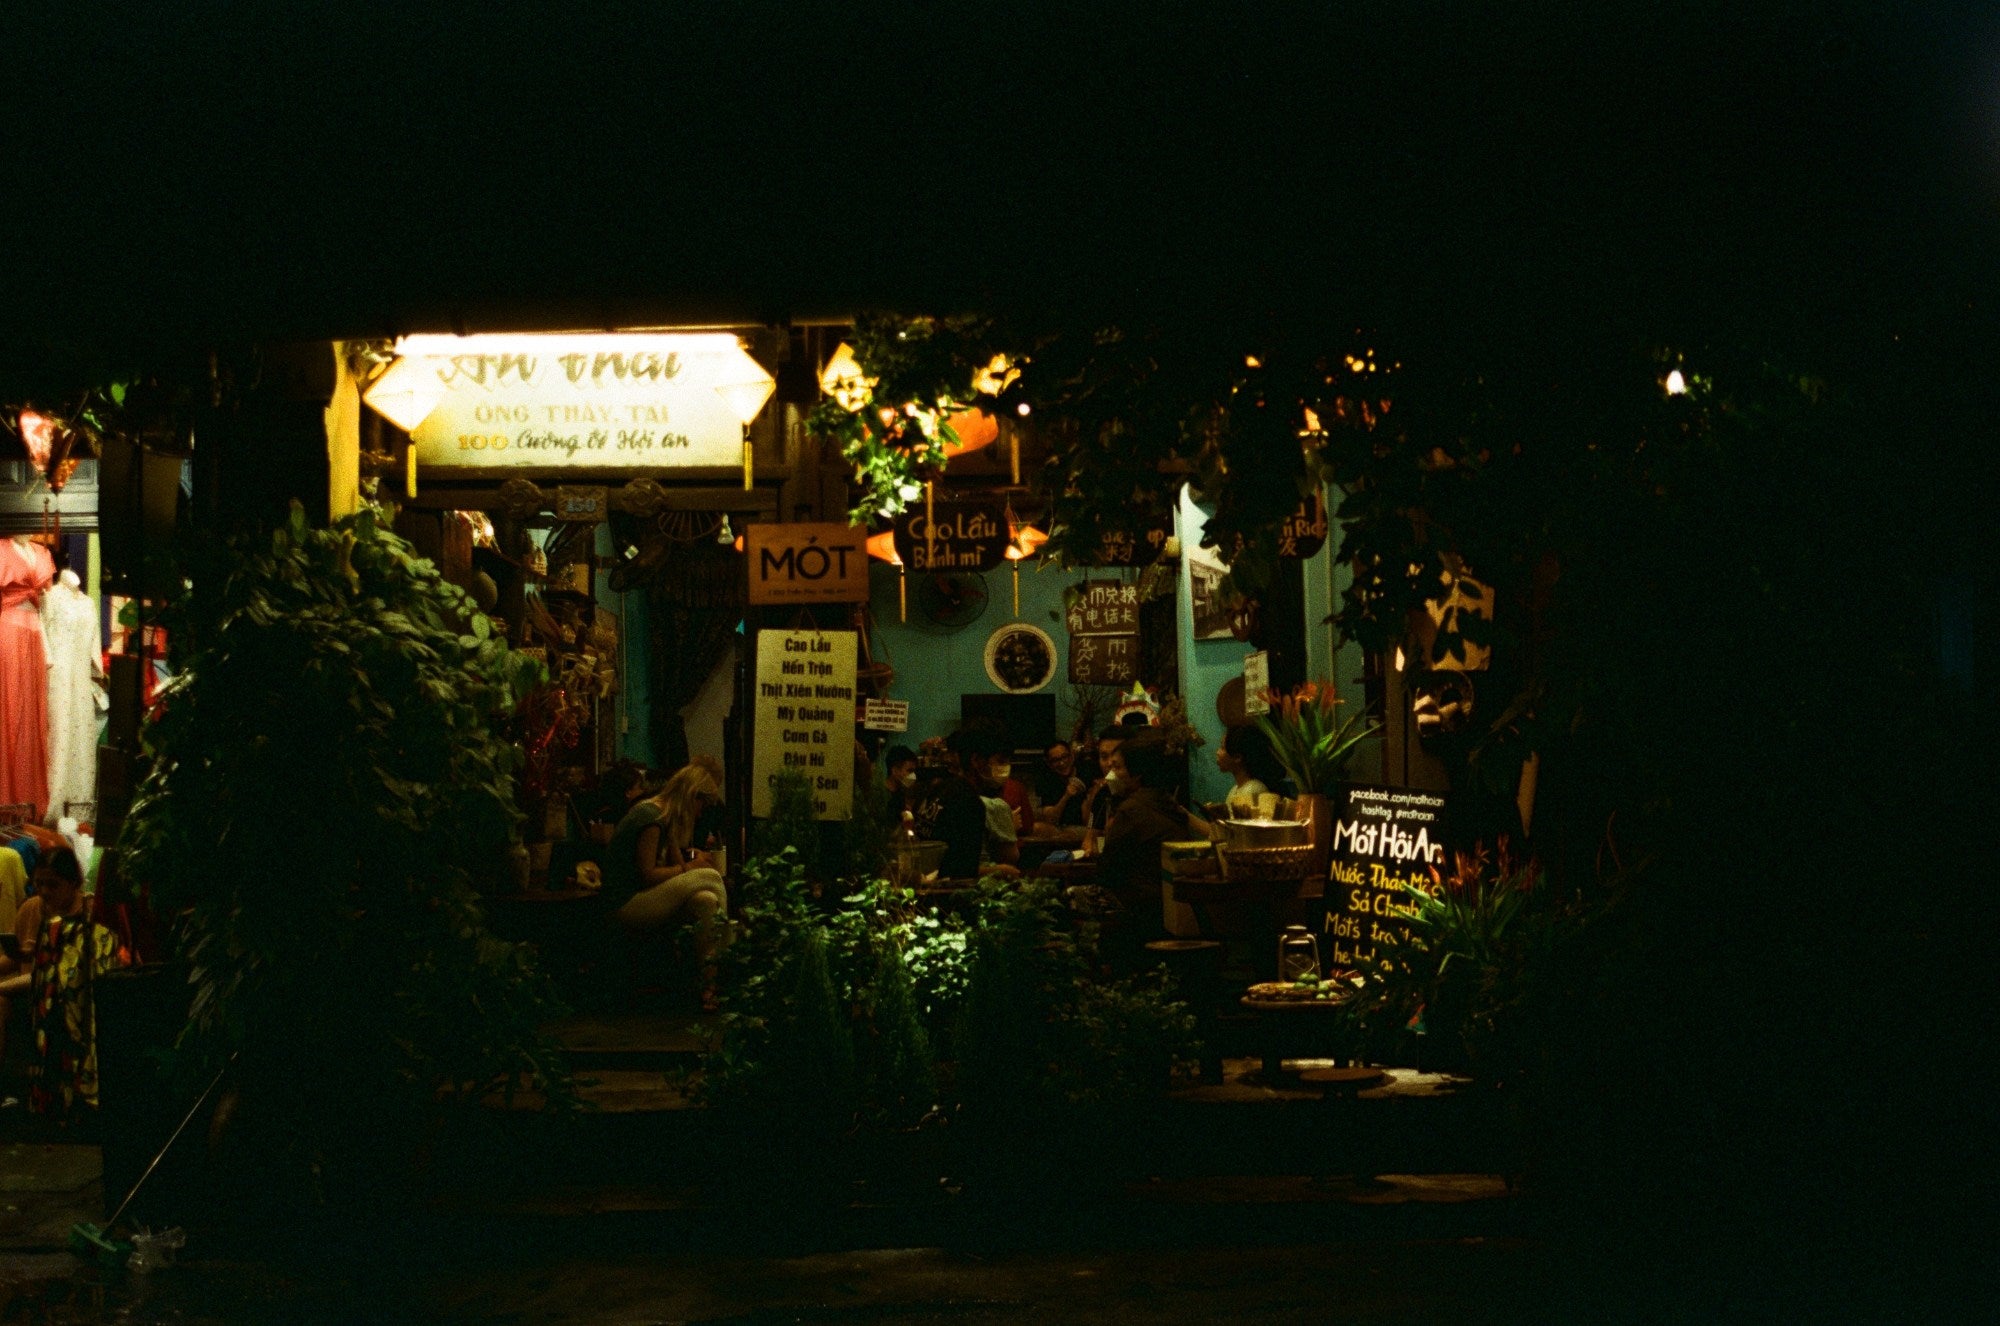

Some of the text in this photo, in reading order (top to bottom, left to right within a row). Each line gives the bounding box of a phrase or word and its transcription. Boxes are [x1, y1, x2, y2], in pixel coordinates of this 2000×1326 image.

[761, 536, 856, 581] MÓT
[785, 638, 807, 652] Cao
[817, 775, 839, 790] Sen
[1334, 818, 1378, 856] Mót
[1378, 822, 1413, 865] Hội
[1330, 860, 1365, 887] Nước
